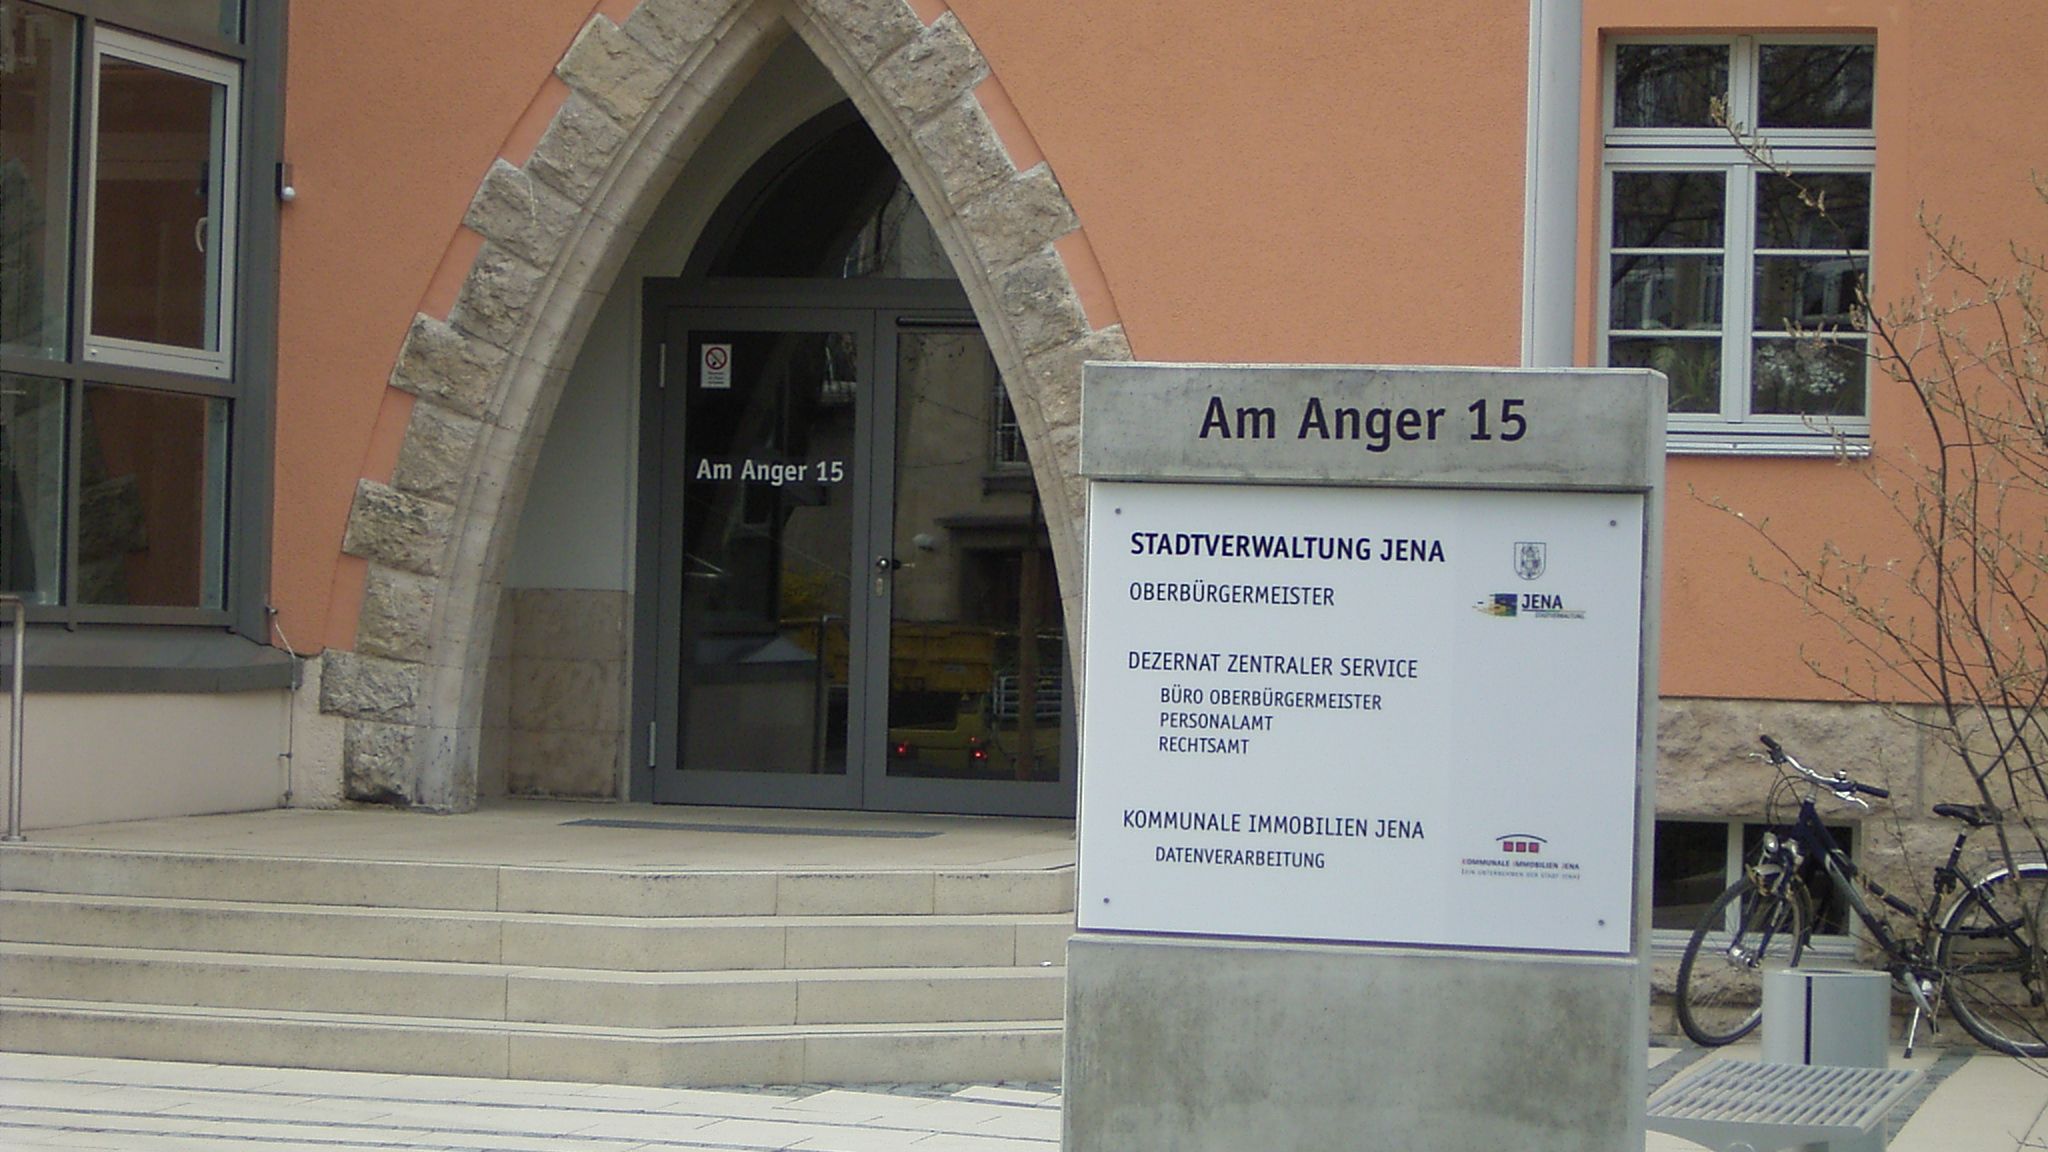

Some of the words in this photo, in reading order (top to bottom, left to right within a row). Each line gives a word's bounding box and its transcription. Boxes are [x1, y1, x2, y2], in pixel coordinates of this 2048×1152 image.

[1199, 397, 1275, 439] Am
[1298, 397, 1446, 452] Anger
[1469, 399, 1526, 441] 15
[697, 459, 732, 479] Am
[741, 460, 807, 486] Anger
[817, 461, 843, 482] 15
[1131, 532, 1370, 560] STADTVERWALTUNG
[1380, 539, 1445, 562] JENA
[1130, 580, 1334, 606] OBERBÜRGERMEISTER
[1522, 594, 1563, 610] JENA
[1129, 652, 1220, 671] DEZERNAT
[1228, 654, 1332, 675] ZENTRALER
[1341, 658, 1417, 678] SERVICE
[1161, 684, 1203, 704] BÜRO
[1210, 688, 1381, 710] OBERBÜRGERMEISTER
[1161, 712, 1273, 730] PERSONALAMT
[1160, 736, 1249, 754] RECHTSAMT
[1124, 810, 1240, 832] KOMMUNALE
[1249, 815, 1367, 836] IMMOBILIEN
[1375, 820, 1424, 839] JENA
[1156, 847, 1324, 868] DATENVERARBEITUNG
